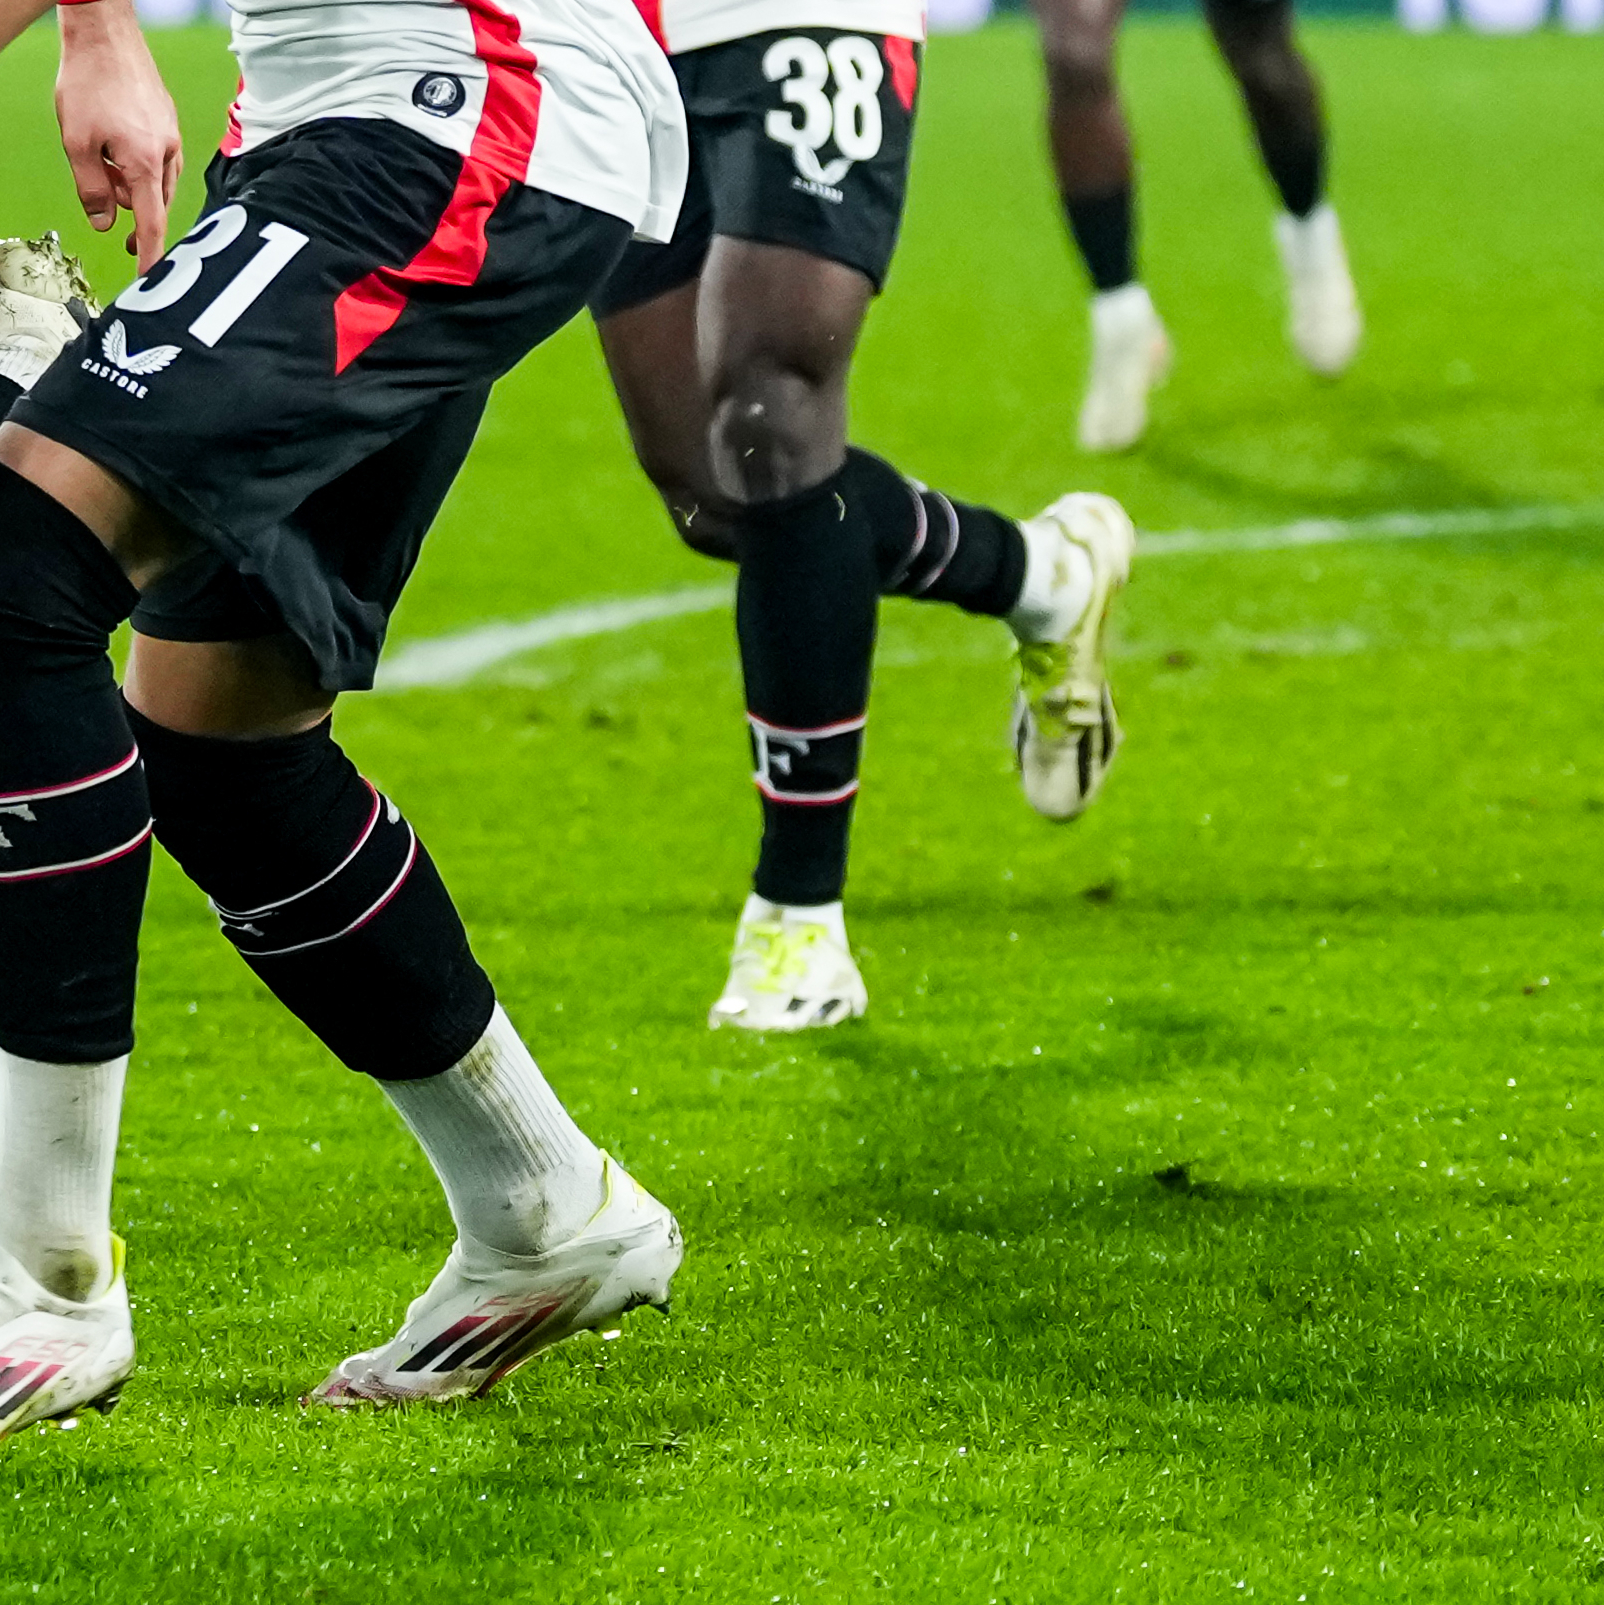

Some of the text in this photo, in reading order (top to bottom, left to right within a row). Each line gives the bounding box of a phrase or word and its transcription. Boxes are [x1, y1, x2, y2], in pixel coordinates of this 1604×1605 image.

[761, 36, 884, 162] 38
[114, 203, 310, 348] 31
[81, 357, 150, 400] CASTORE
